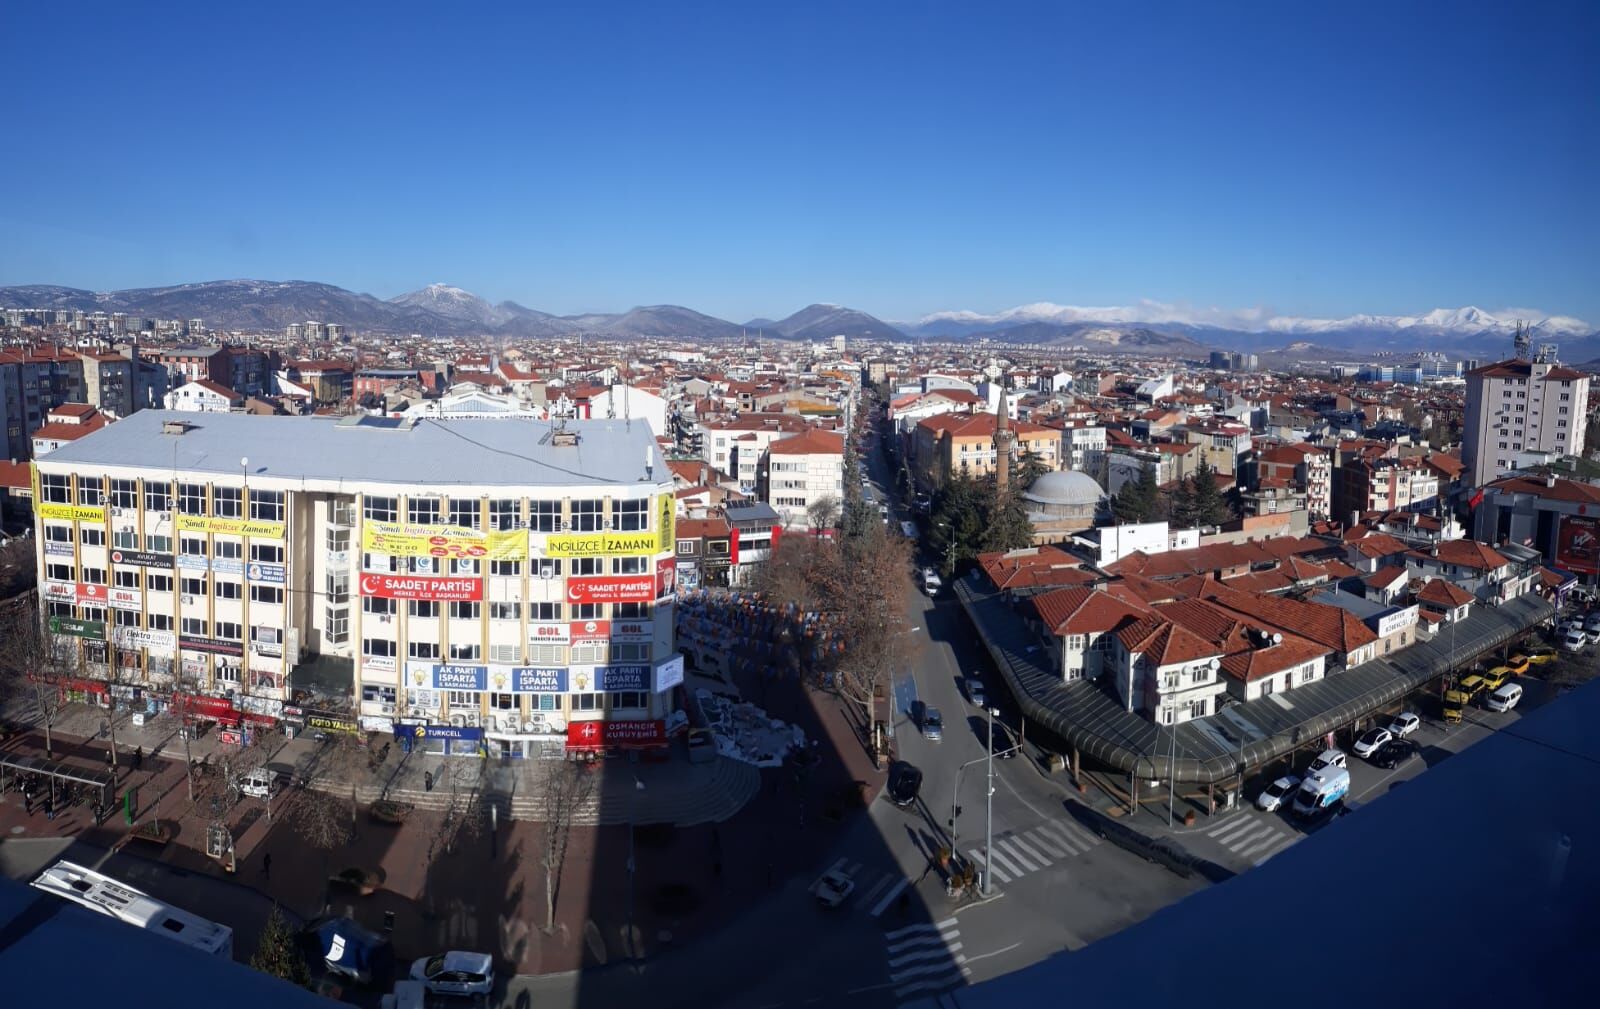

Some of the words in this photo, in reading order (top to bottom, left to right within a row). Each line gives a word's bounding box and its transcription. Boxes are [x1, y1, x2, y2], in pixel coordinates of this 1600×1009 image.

[75, 510, 102, 520] ZAMANI
[550, 538, 600, 552] İNGİLİZCE
[608, 540, 654, 550] ZAMANI
[385, 579, 428, 591] SAADET
[432, 580, 476, 592] PARTİSİ
[588, 583, 618, 592] SAADET
[620, 581, 652, 592] PARTİSİ
[436, 592, 470, 600] BAŞKANLIĞI
[454, 666, 476, 674] PARTİ
[536, 669, 558, 677] PARTİ
[605, 668, 616, 676] AK
[620, 666, 642, 674] PARTİ
[439, 674, 476, 682] ISPARTA
[520, 676, 558, 686] ISPARTA
[604, 674, 641, 684] ISPARTA
[312, 718, 331, 727] FOTO
[428, 730, 462, 738] TURKCELL
